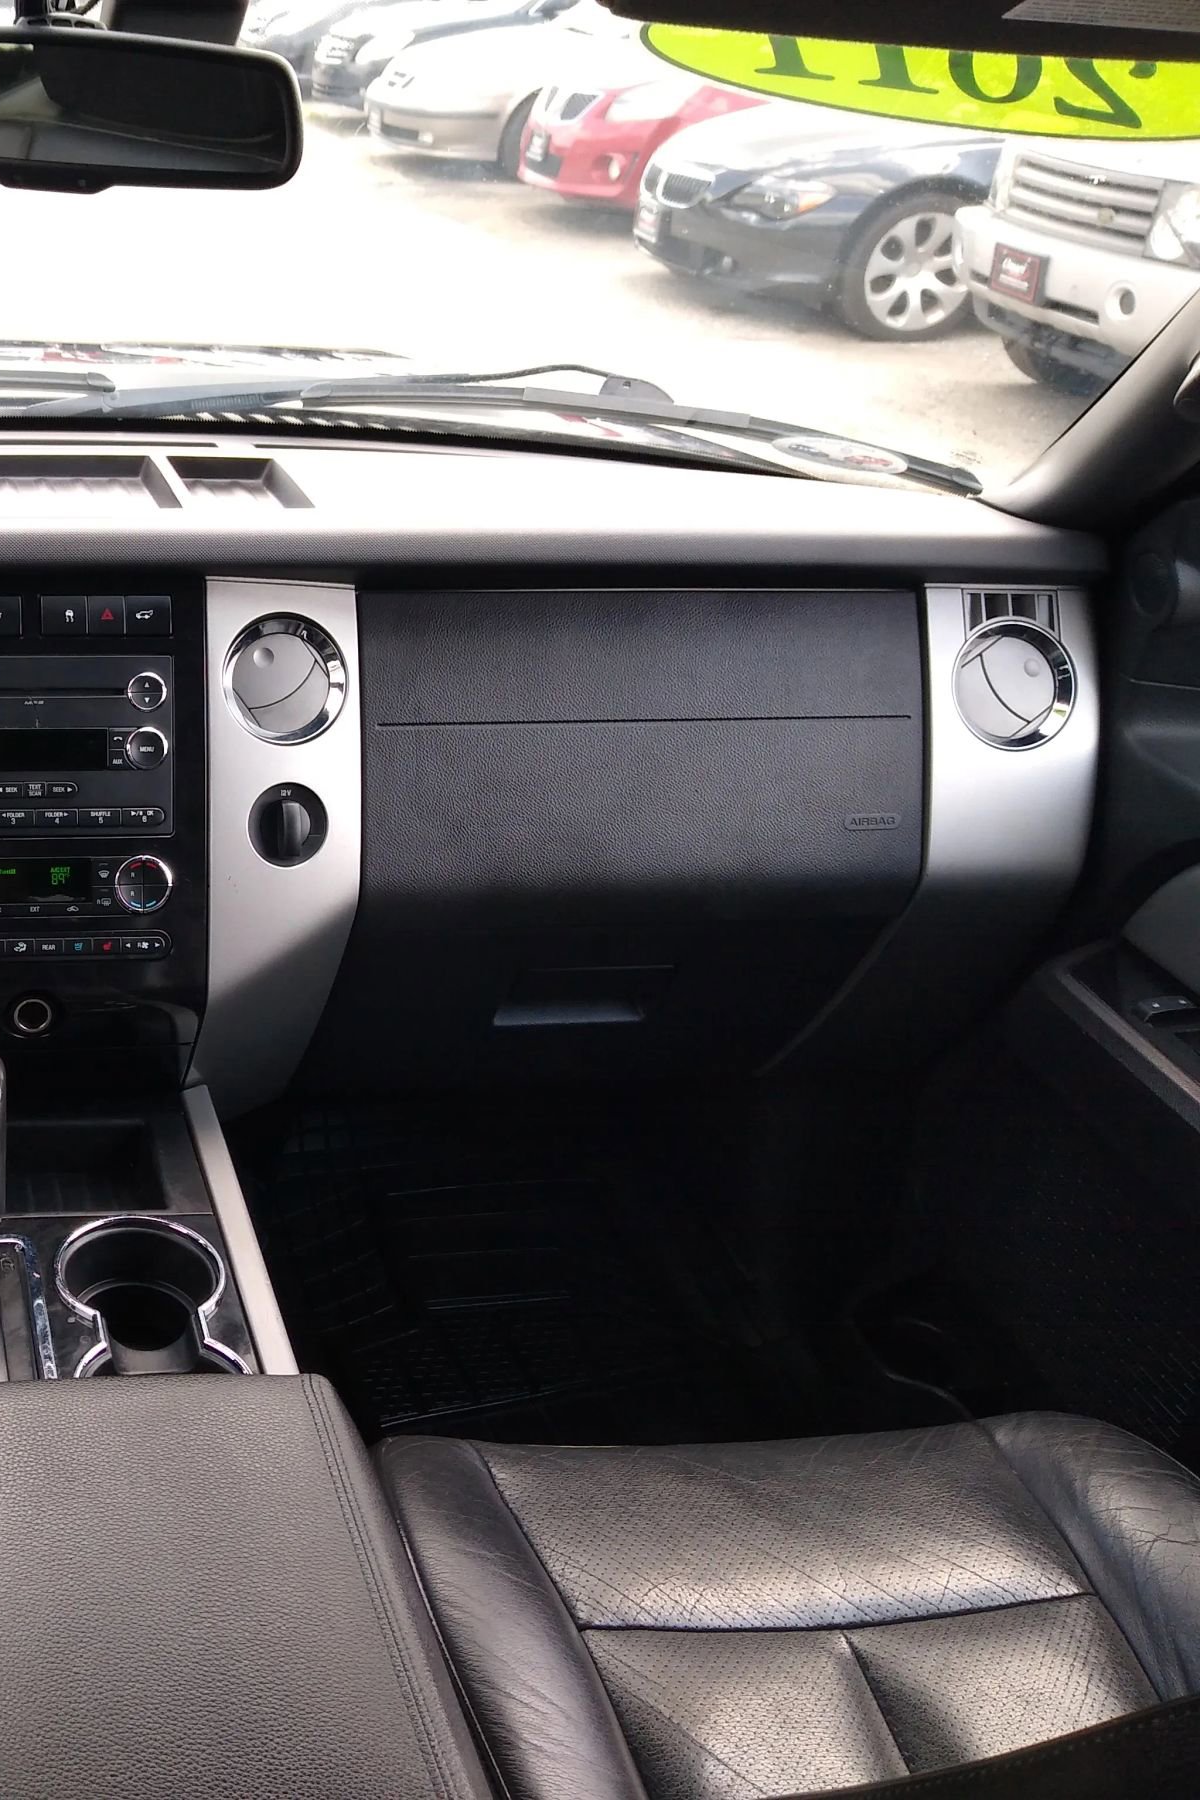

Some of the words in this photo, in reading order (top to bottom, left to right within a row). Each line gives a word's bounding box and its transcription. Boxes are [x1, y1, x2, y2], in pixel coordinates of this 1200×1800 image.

[11, 817, 16, 825] 3
[142, 815, 147, 823] 6
[849, 817, 896, 827] AIRBAG
